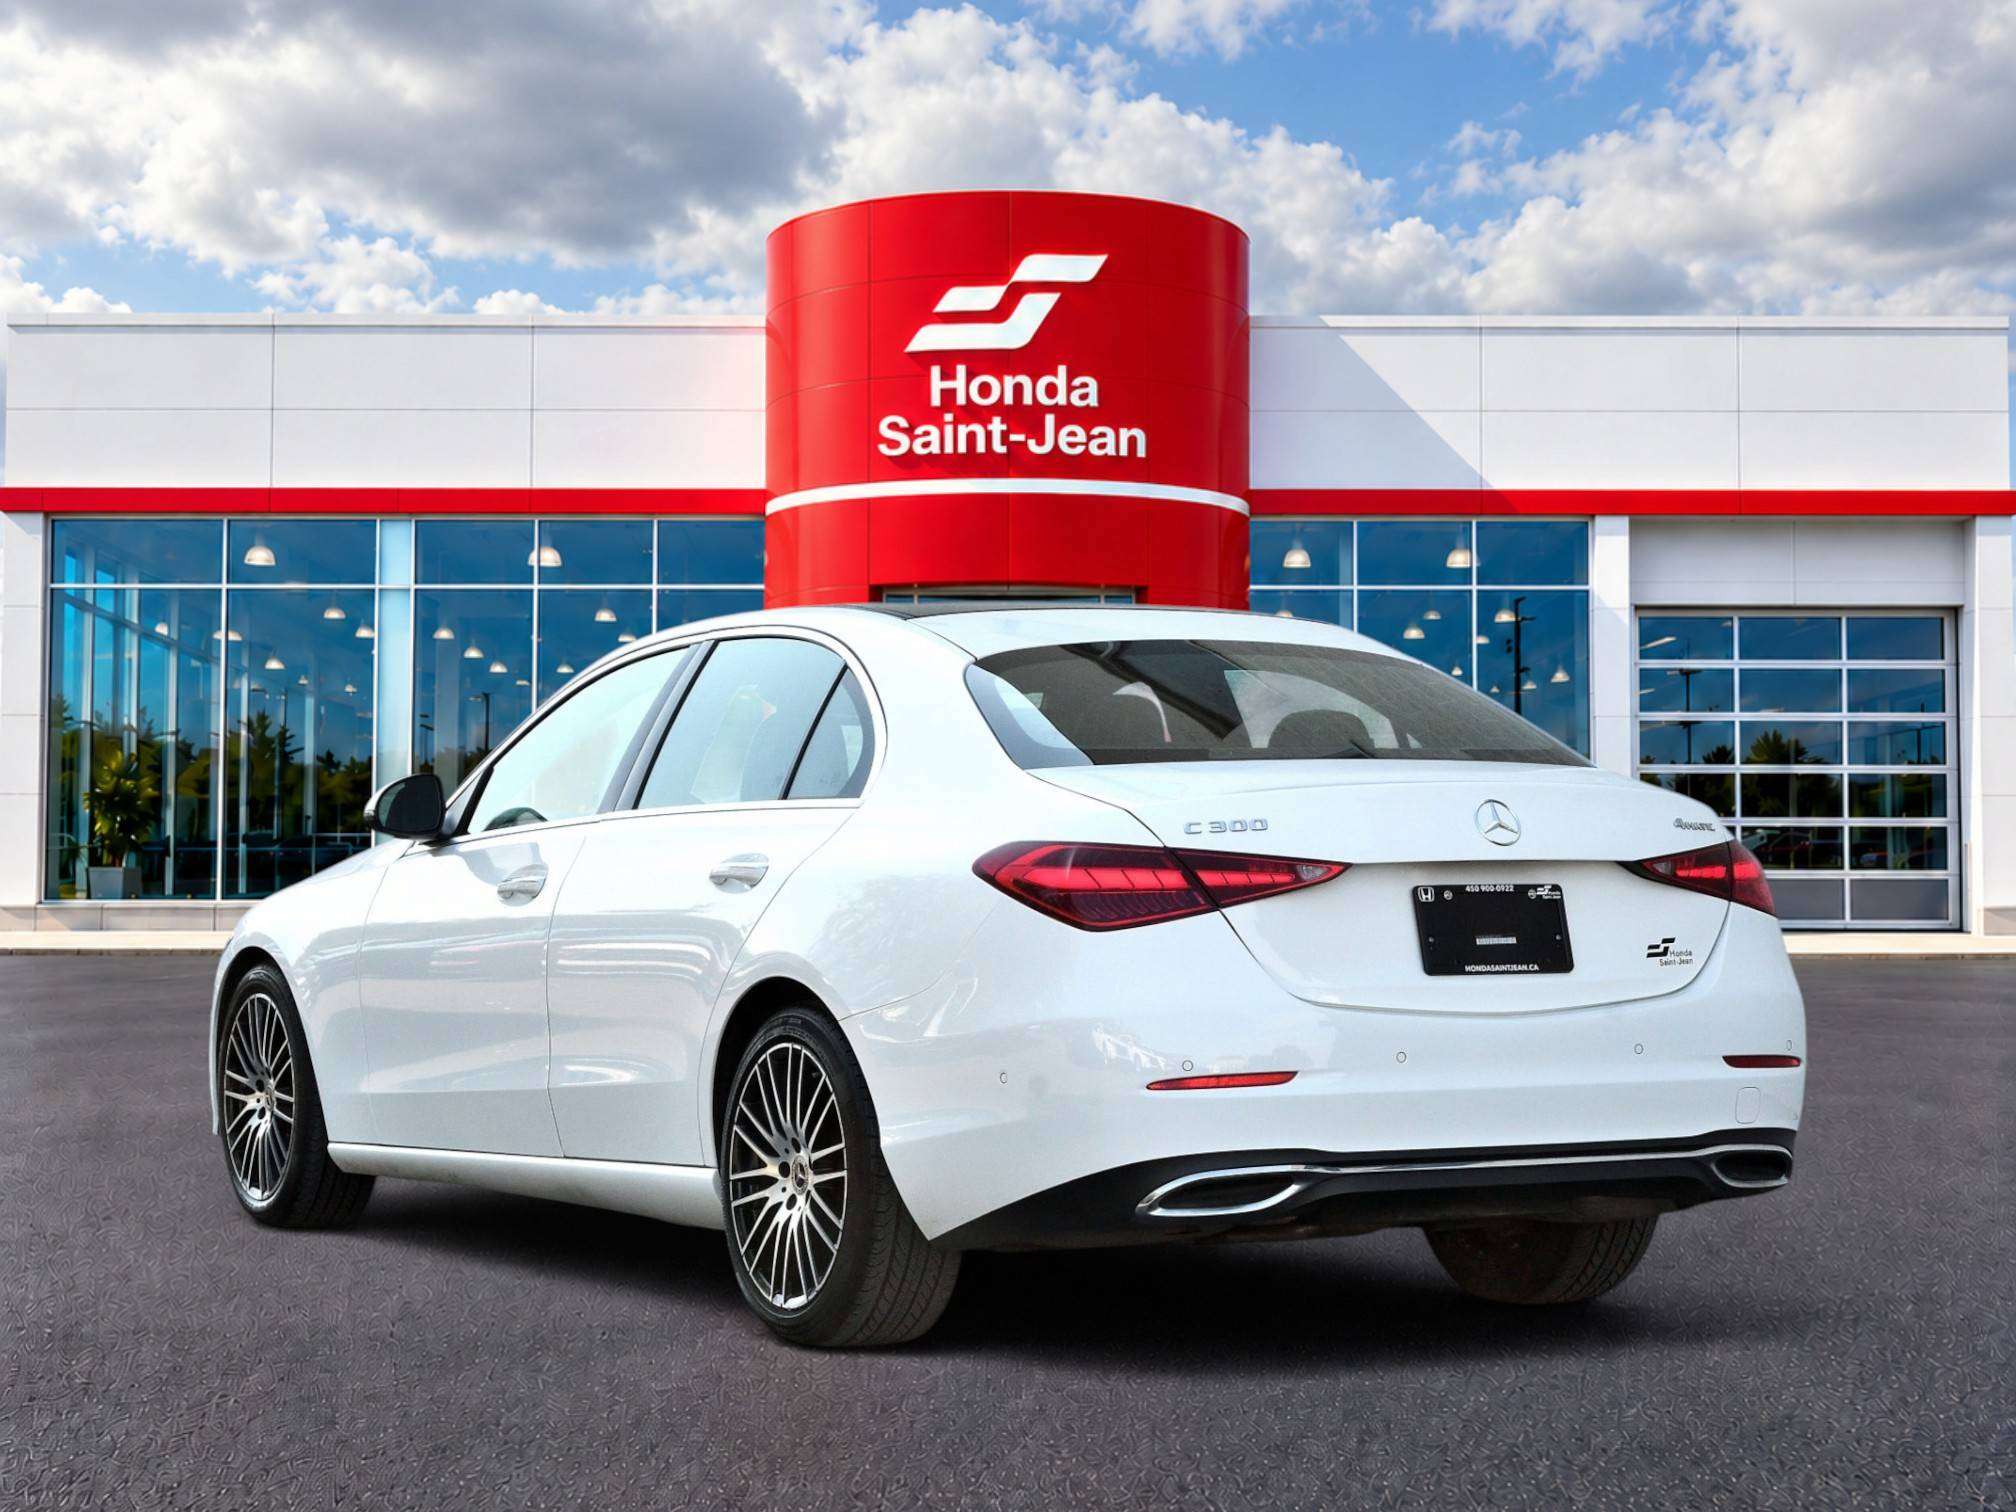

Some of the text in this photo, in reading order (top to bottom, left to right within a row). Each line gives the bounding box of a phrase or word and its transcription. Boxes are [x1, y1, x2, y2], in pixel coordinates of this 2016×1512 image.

[930, 365, 1099, 407] Honda
[877, 412, 1147, 458] Saint-Jean
[1184, 819, 1268, 835] C 300
[1465, 884, 1480, 893] 450
[1464, 963, 1540, 972] HONDASAINTJEAN.CA
